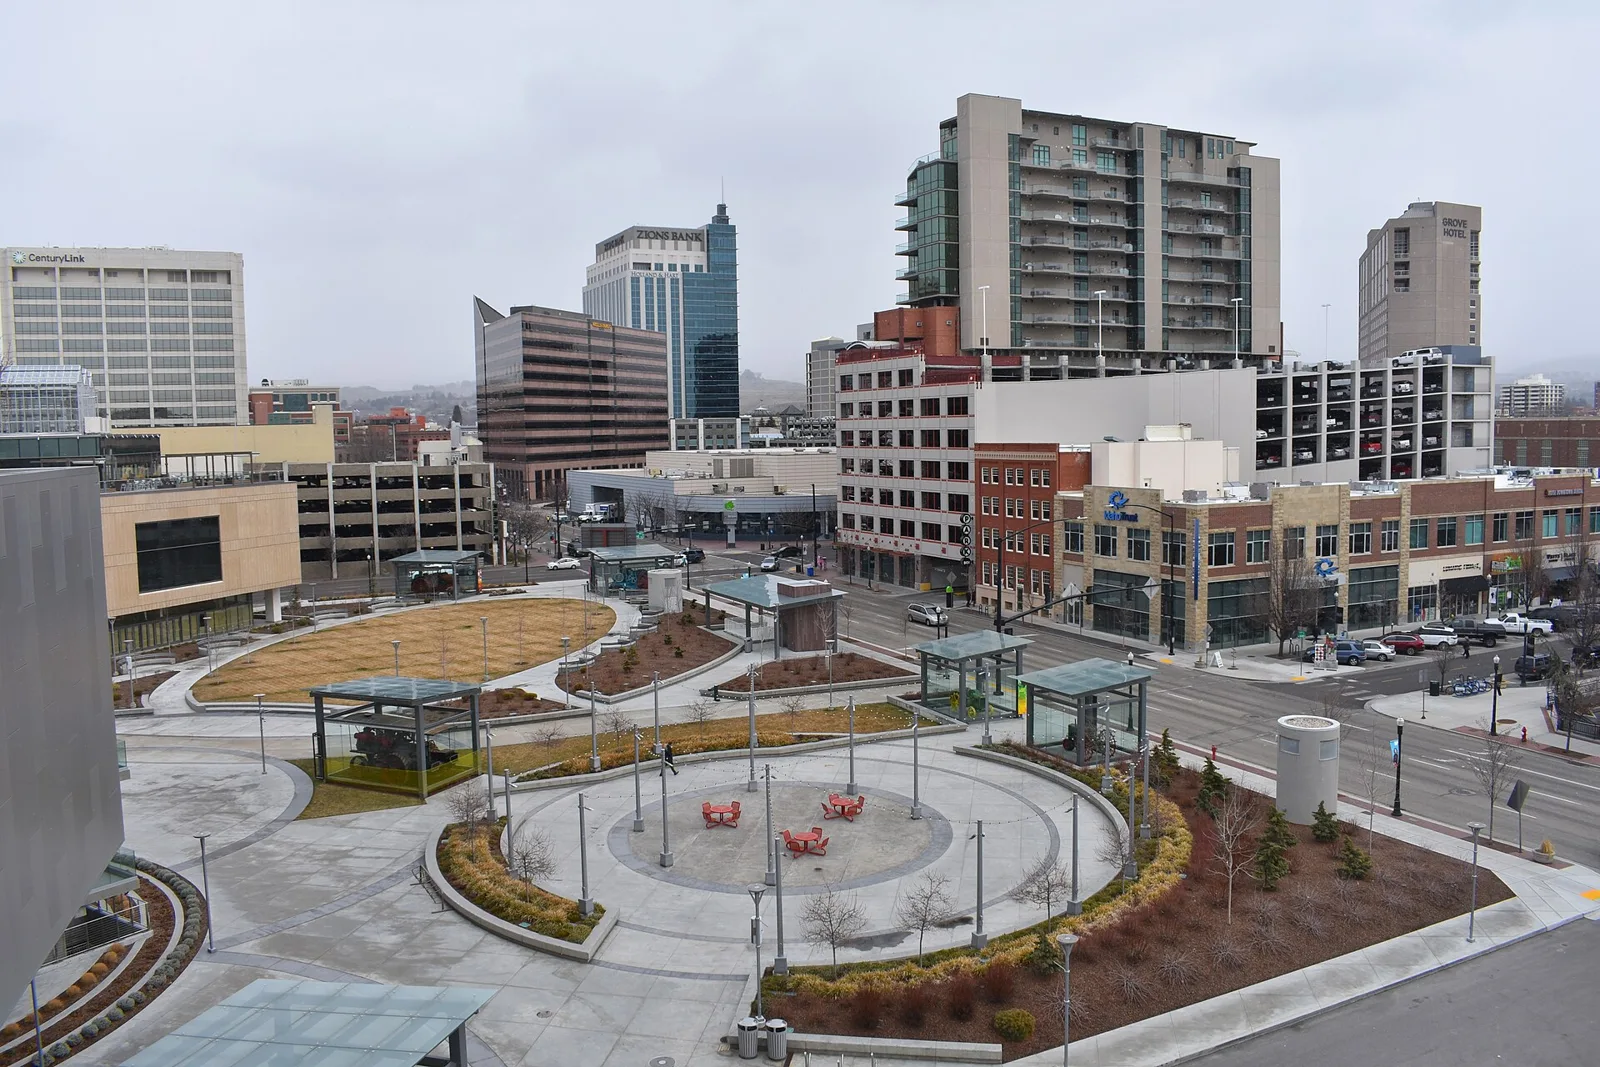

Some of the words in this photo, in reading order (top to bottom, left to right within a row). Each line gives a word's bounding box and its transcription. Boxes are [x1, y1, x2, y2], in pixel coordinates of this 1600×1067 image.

[1442, 217, 1468, 229] GROVE
[636, 229, 669, 241] ZIONS
[671, 231, 703, 242] BANK
[1443, 228, 1467, 239] HOTEL
[28, 253, 85, 264] CenturyLink
[962, 514, 972, 557] PARK
